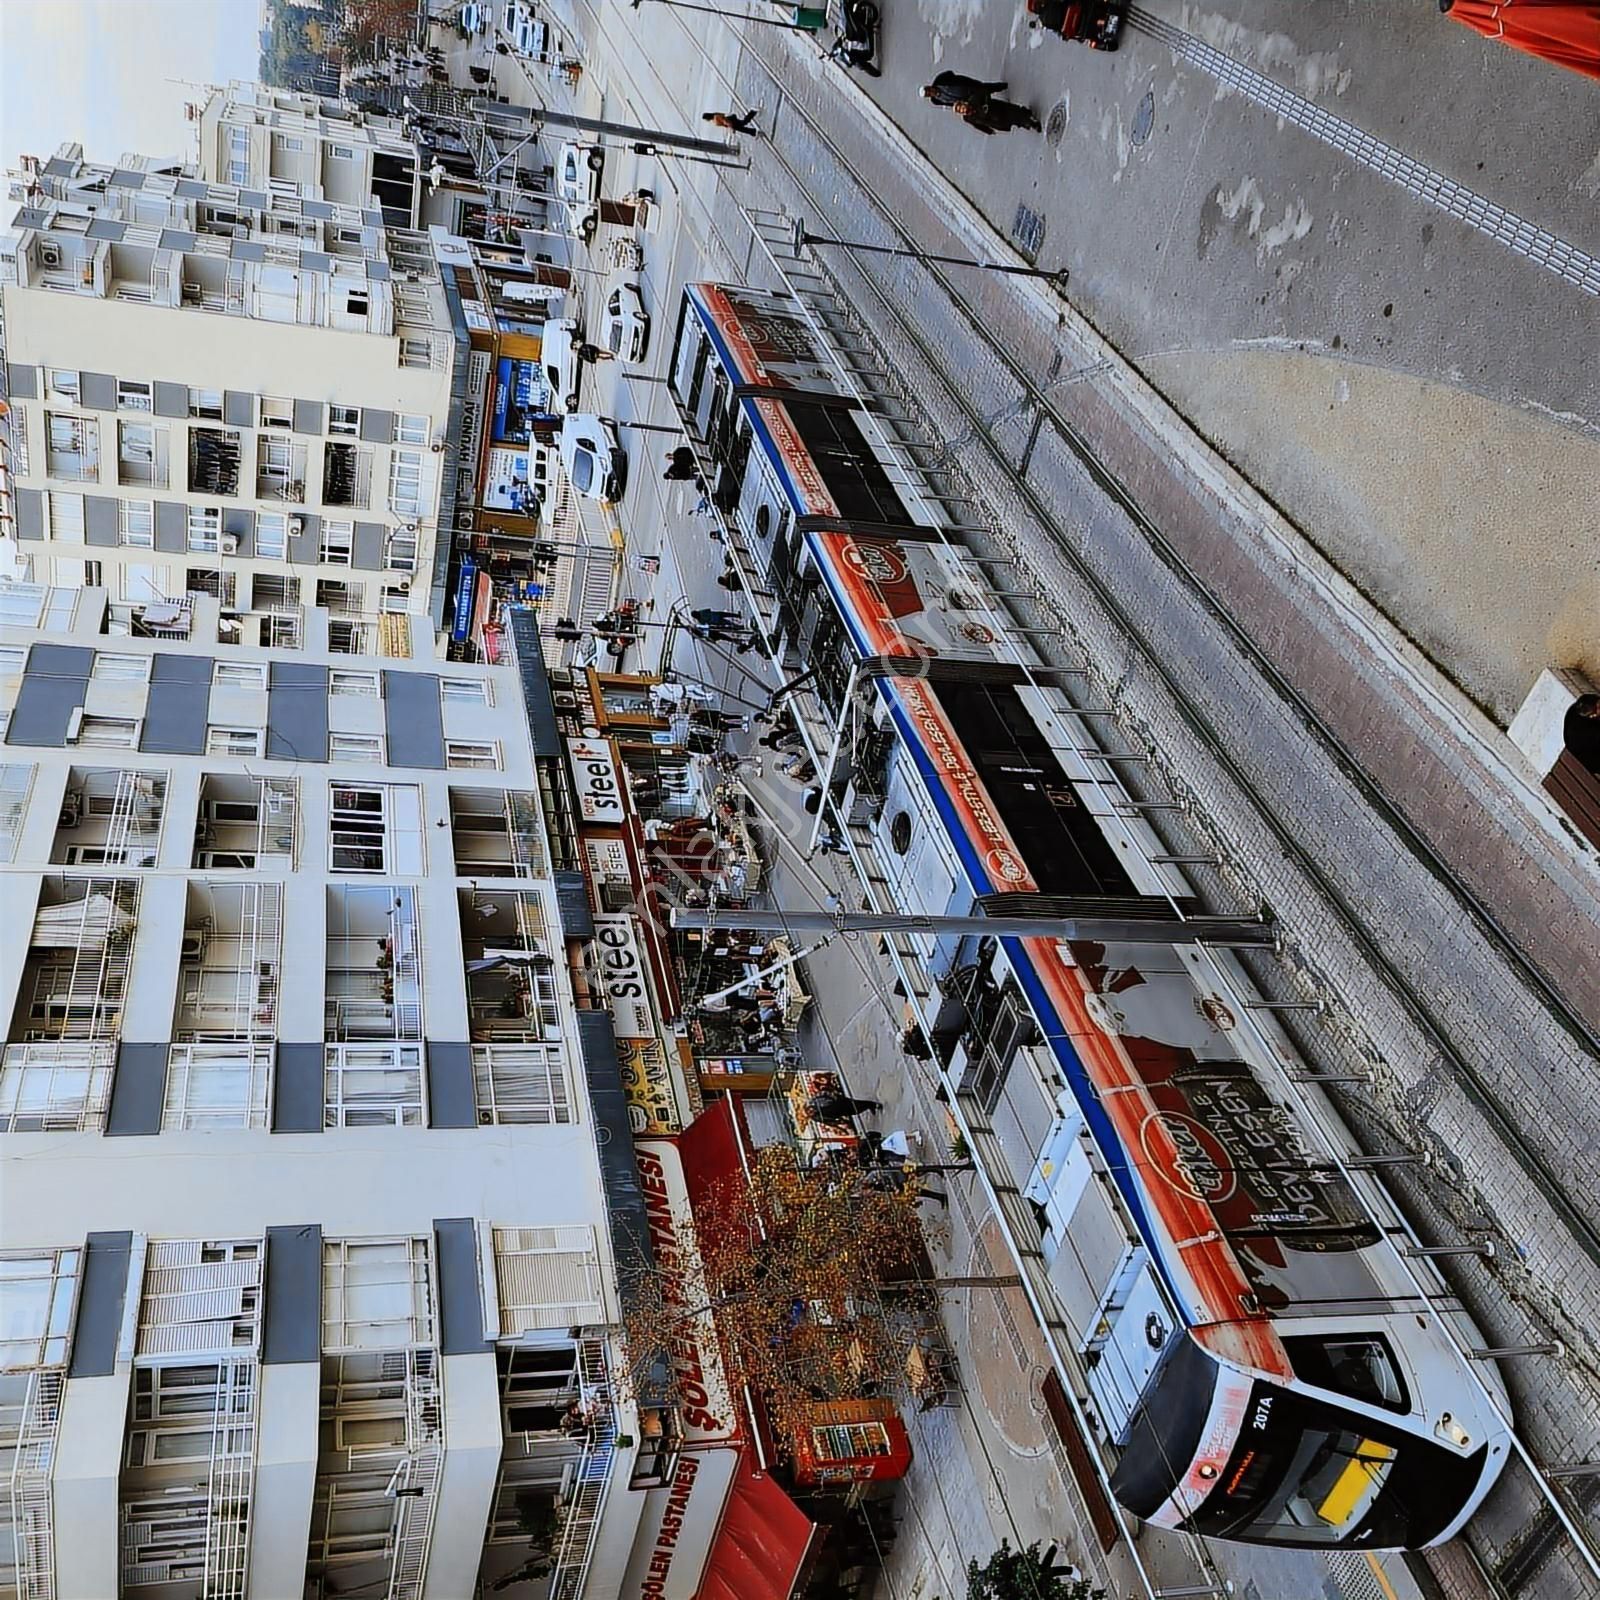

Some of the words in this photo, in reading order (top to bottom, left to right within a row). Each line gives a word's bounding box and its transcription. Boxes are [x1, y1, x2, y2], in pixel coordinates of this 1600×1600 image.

[459, 400, 475, 462] HYUNDAI
[574, 689, 592, 703] PET
[576, 757, 619, 809] steel
[607, 841, 623, 869] STEEL
[592, 920, 642, 998] steel
[1252, 1396, 1274, 1430] 207A
